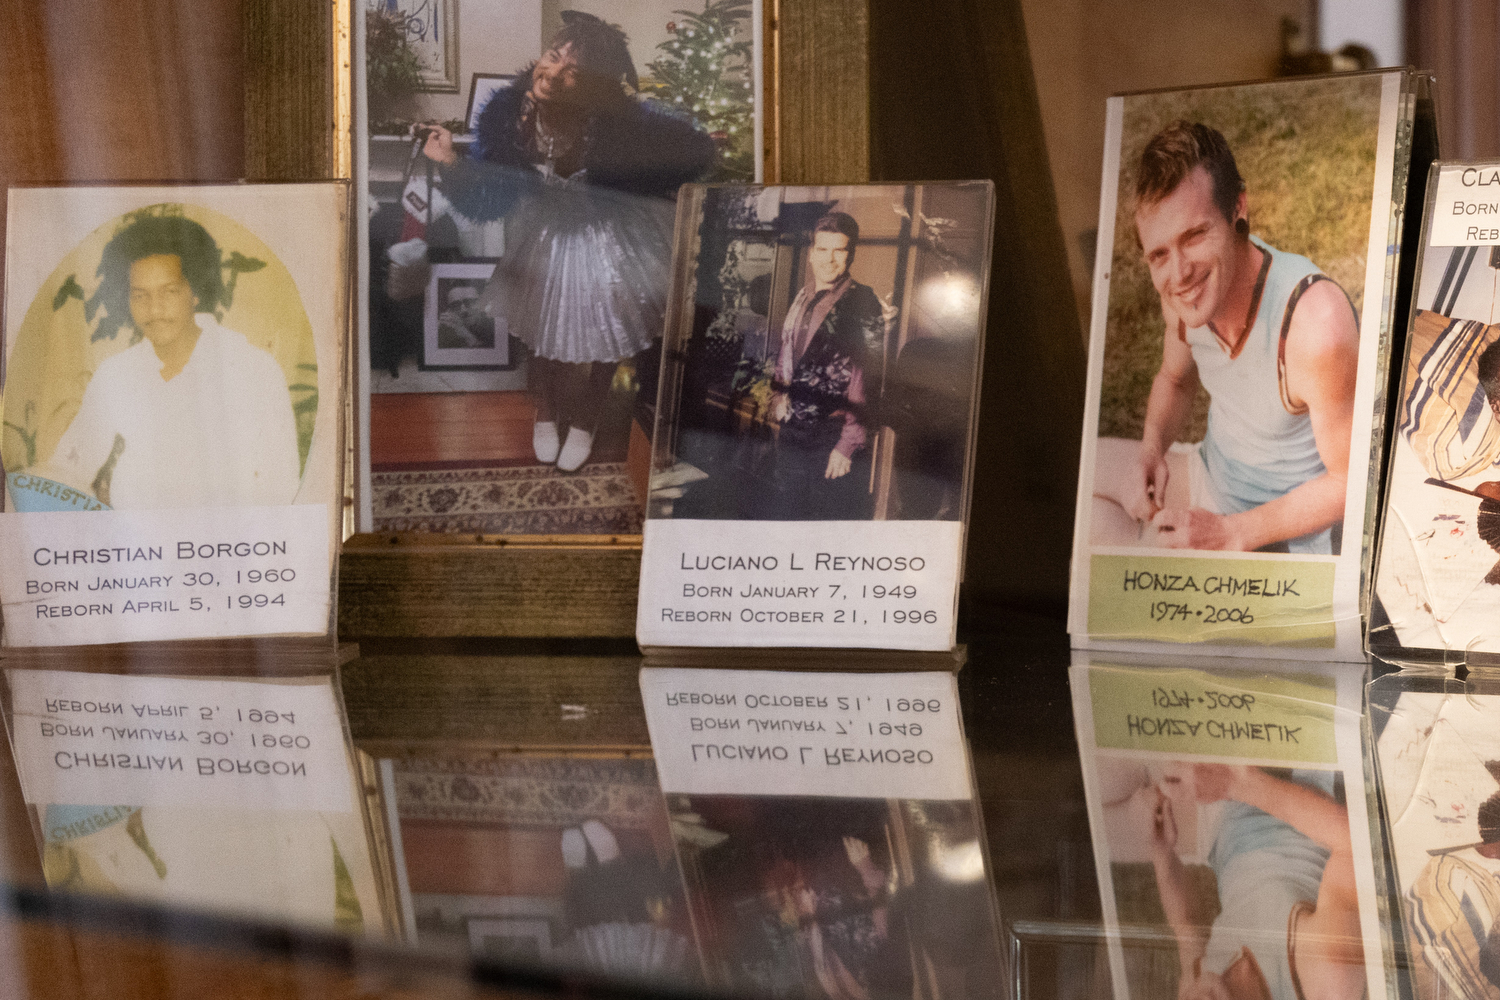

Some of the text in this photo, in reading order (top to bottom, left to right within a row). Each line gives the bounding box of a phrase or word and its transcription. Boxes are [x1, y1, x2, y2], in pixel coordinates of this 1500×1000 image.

[1451, 200, 1499, 216] BORN
[32, 540, 287, 567] CHRISTIAN BORGON
[680, 552, 926, 572] LUCIANO L REYNOSO
[25, 567, 297, 595] BORN JANUARY 30, 1960
[682, 582, 917, 600] BORN JANUARY 7, 1949
[1123, 570, 1300, 598] HONZA CHMELIK
[35, 592, 286, 619] REBORN APRIL 5, 1994
[661, 607, 938, 625] REBORN OCTOBER 21, 1996
